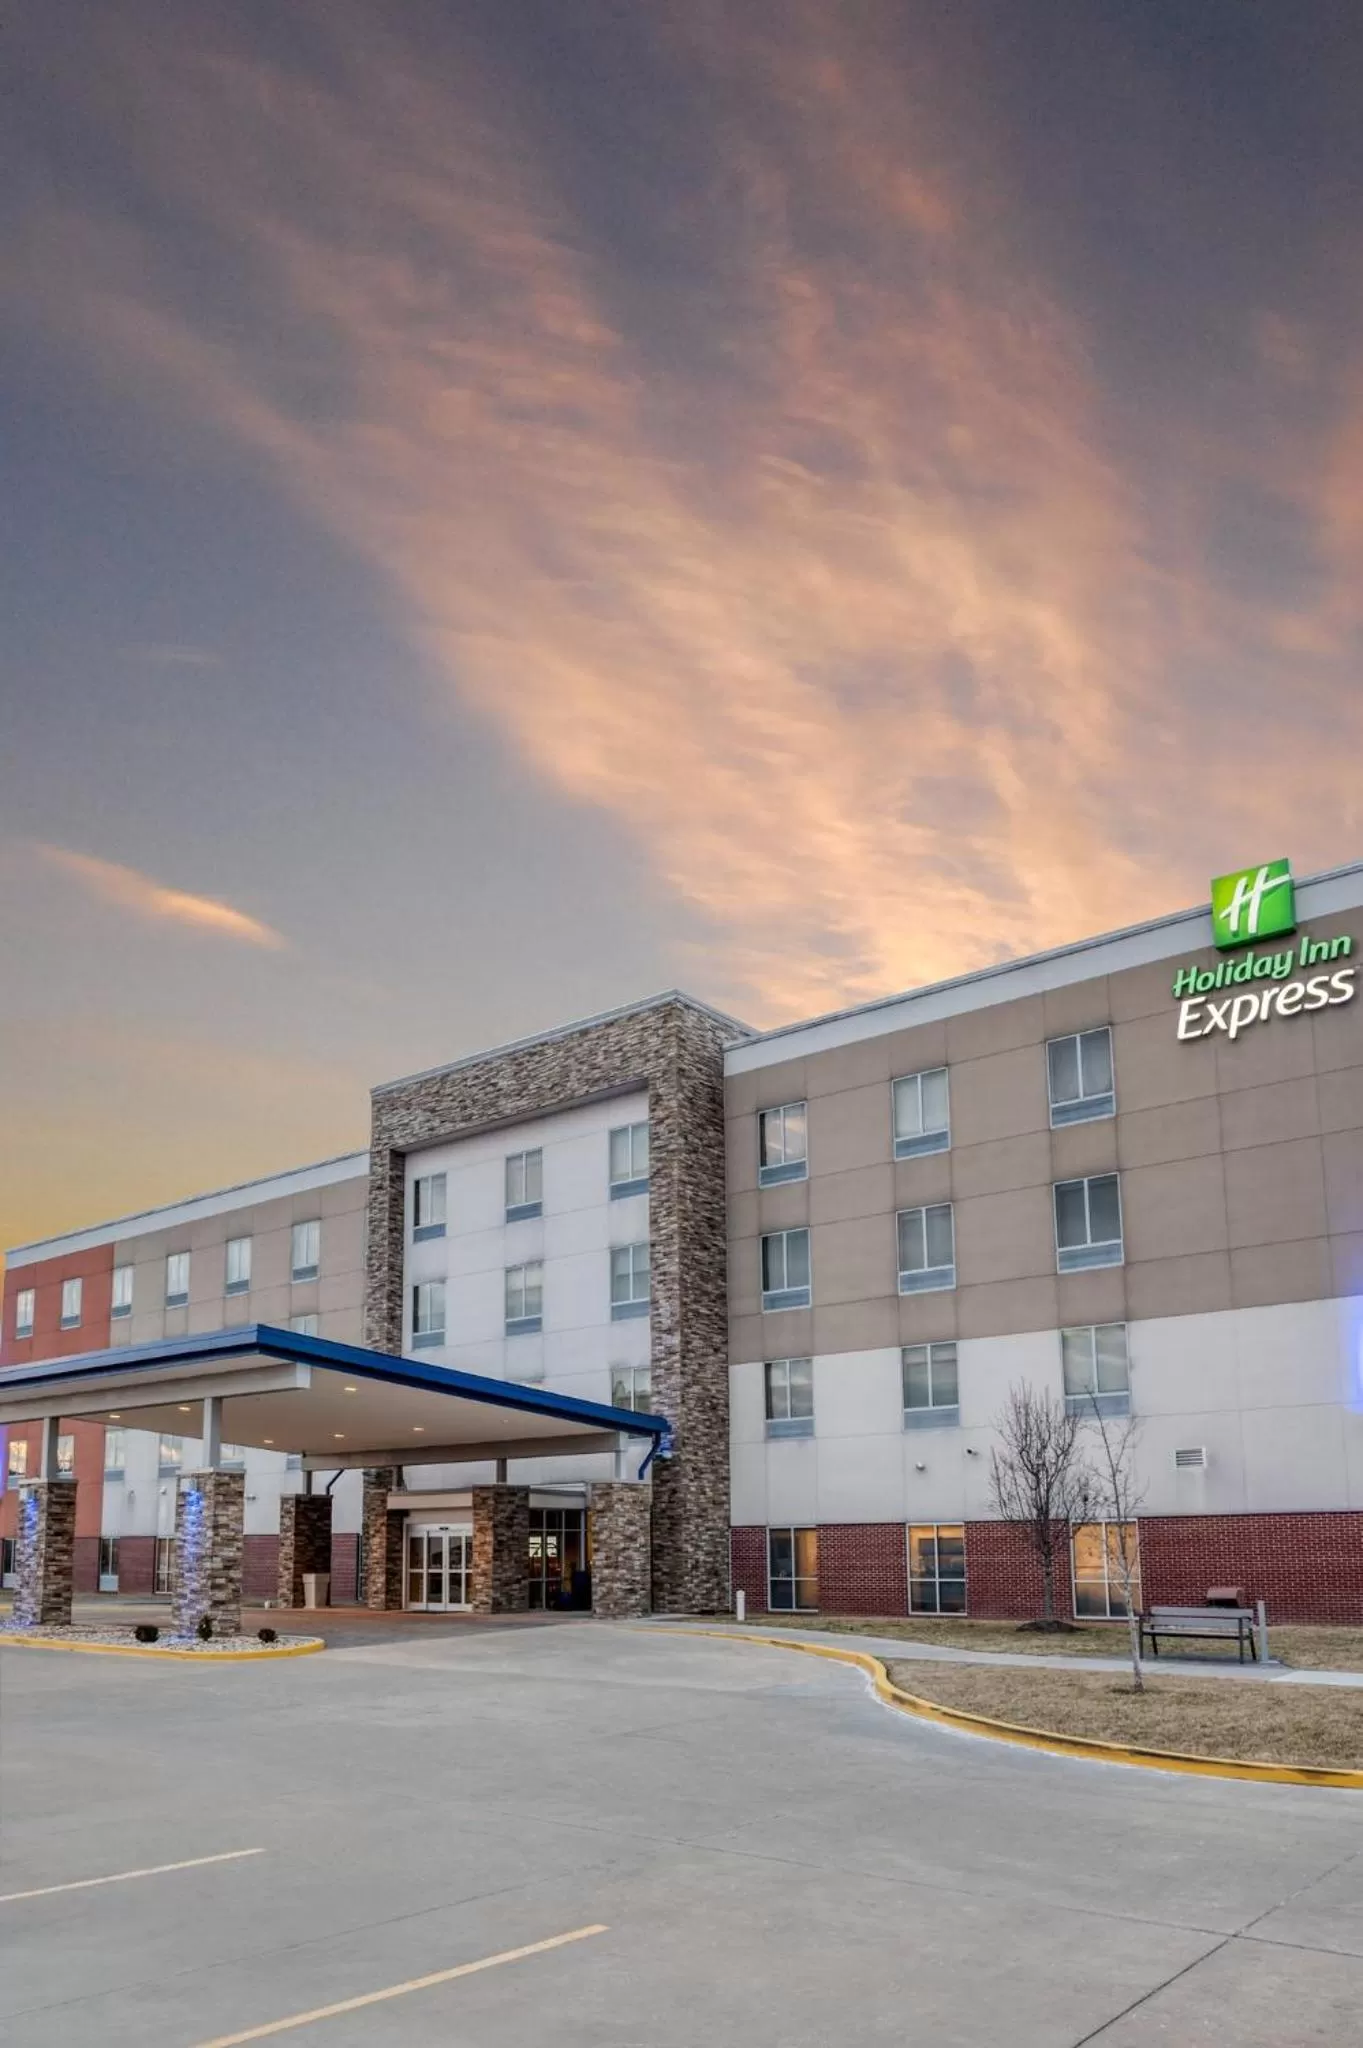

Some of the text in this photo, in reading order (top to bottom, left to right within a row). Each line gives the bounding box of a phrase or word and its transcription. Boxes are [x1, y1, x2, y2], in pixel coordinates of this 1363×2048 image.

[1219, 866, 1291, 934] H
[1173, 935, 1351, 998] Holiday Inn
[1177, 969, 1355, 1040] Express
